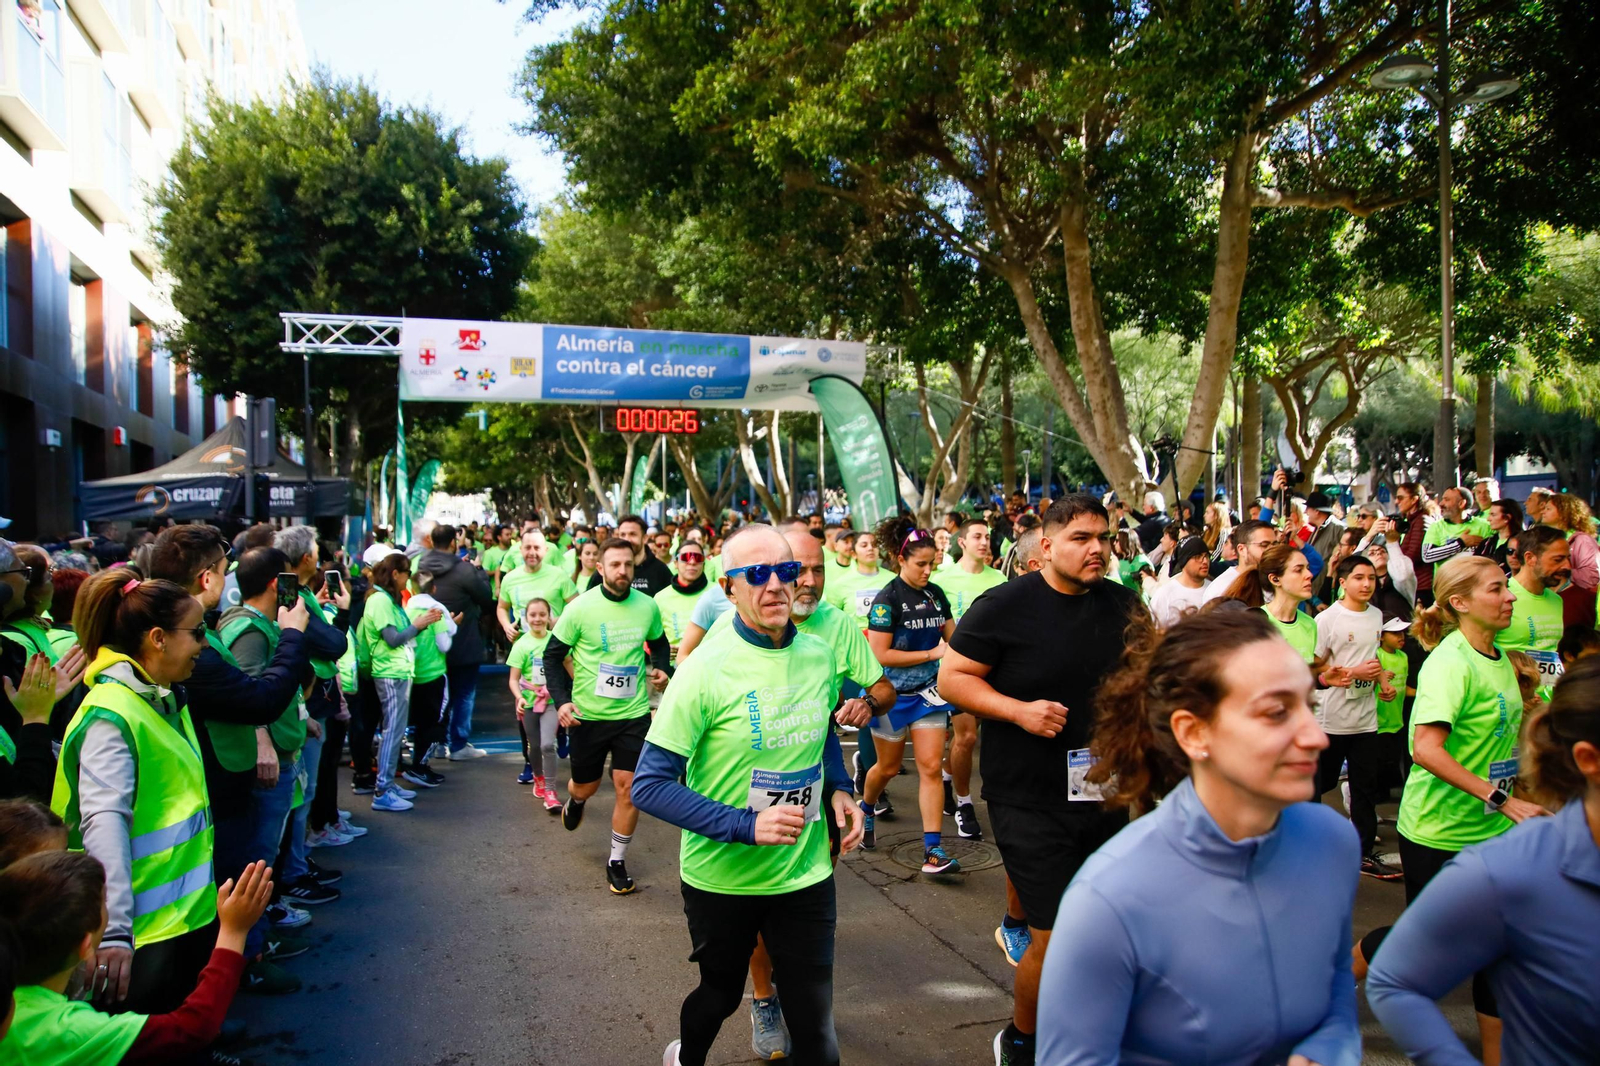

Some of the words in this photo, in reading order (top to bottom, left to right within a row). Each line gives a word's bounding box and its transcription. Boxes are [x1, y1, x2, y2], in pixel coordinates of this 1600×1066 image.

[556, 334, 634, 354] Almería
[640, 342, 662, 354] en
[669, 340, 740, 358] marcha
[556, 358, 622, 375] contra
[626, 359, 646, 376] el
[650, 360, 717, 378] cáncer
[904, 619, 924, 630] SAN
[1538, 662, 1564, 676] 503
[606, 676, 630, 688] 451
[763, 705, 779, 716] En
[782, 698, 821, 714] marcha
[1494, 692, 1507, 738] ALMERÍA
[745, 690, 762, 750] ALMERÍA
[765, 714, 810, 731] contra
[812, 708, 823, 722] el
[766, 727, 825, 749] cáncer
[767, 786, 812, 807] 758
